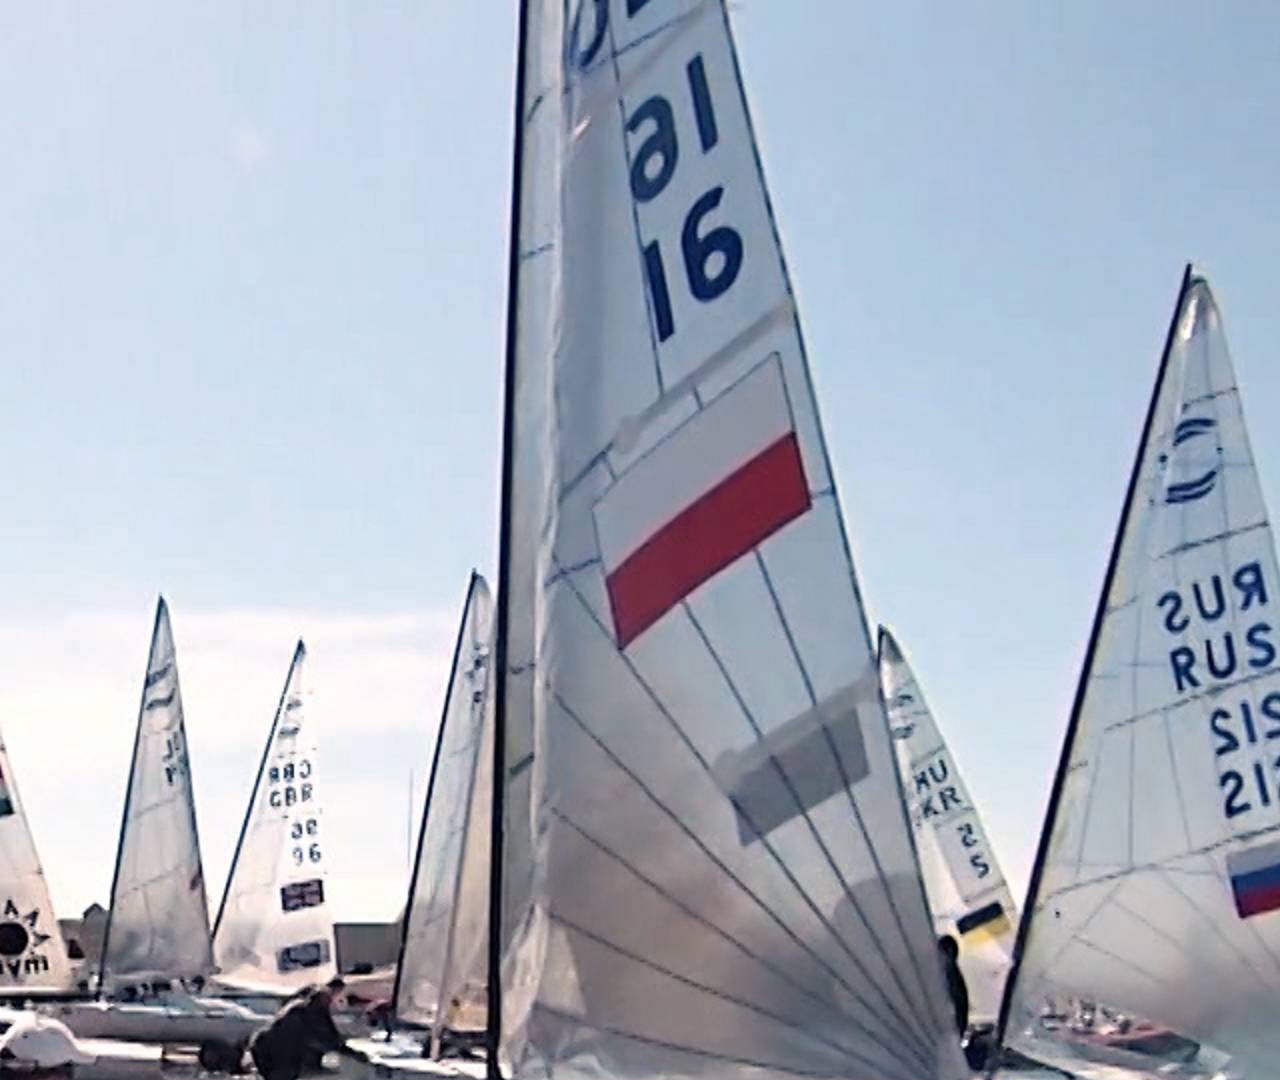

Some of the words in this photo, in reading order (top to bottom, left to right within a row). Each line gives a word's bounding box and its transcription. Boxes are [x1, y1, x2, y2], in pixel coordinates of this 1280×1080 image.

[643, 186, 743, 343] 16
[1170, 623, 1276, 692] RUS
[270, 783, 313, 807] GBR
